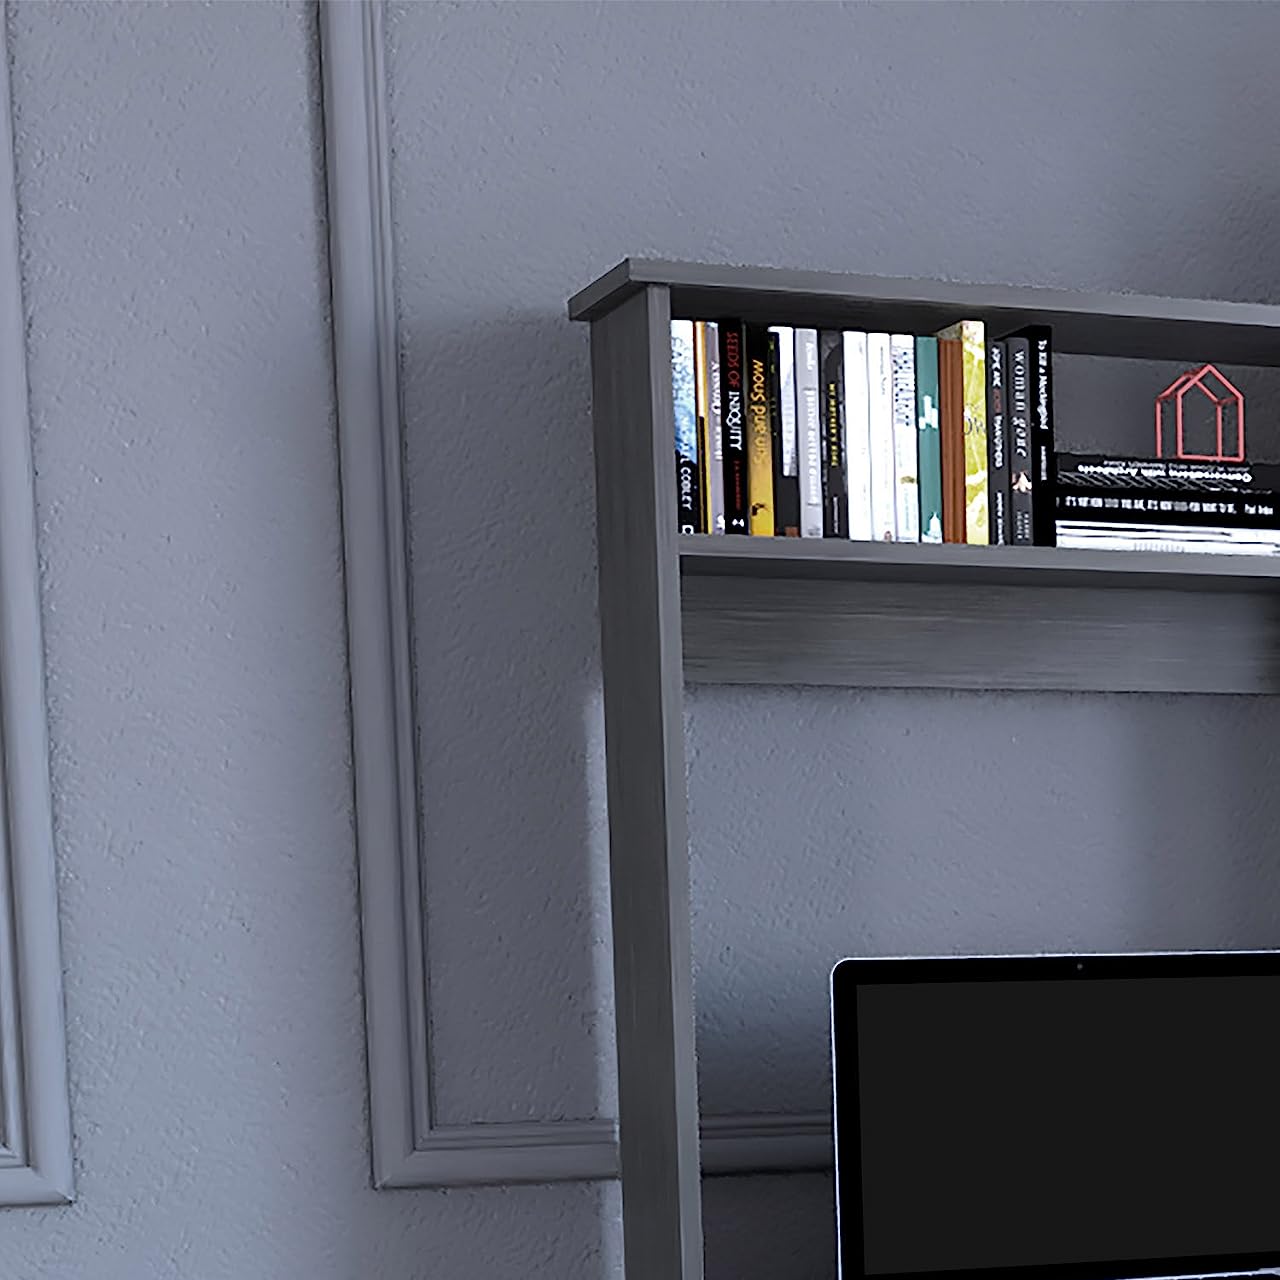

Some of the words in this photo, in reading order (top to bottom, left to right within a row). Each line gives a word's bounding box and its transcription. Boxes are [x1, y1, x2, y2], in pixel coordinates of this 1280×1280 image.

[726, 331, 740, 368] SEEDS
[1037, 339, 1047, 350] To
[1037, 352, 1047, 366] Kill
[727, 370, 740, 388] OF
[750, 359, 767, 402] Snow
[1014, 350, 1026, 412] woman
[1037, 374, 1049, 430] Mockingbird
[726, 391, 743, 451] INIQUITY
[750, 404, 767, 435] and
[753, 437, 767, 465] Sun
